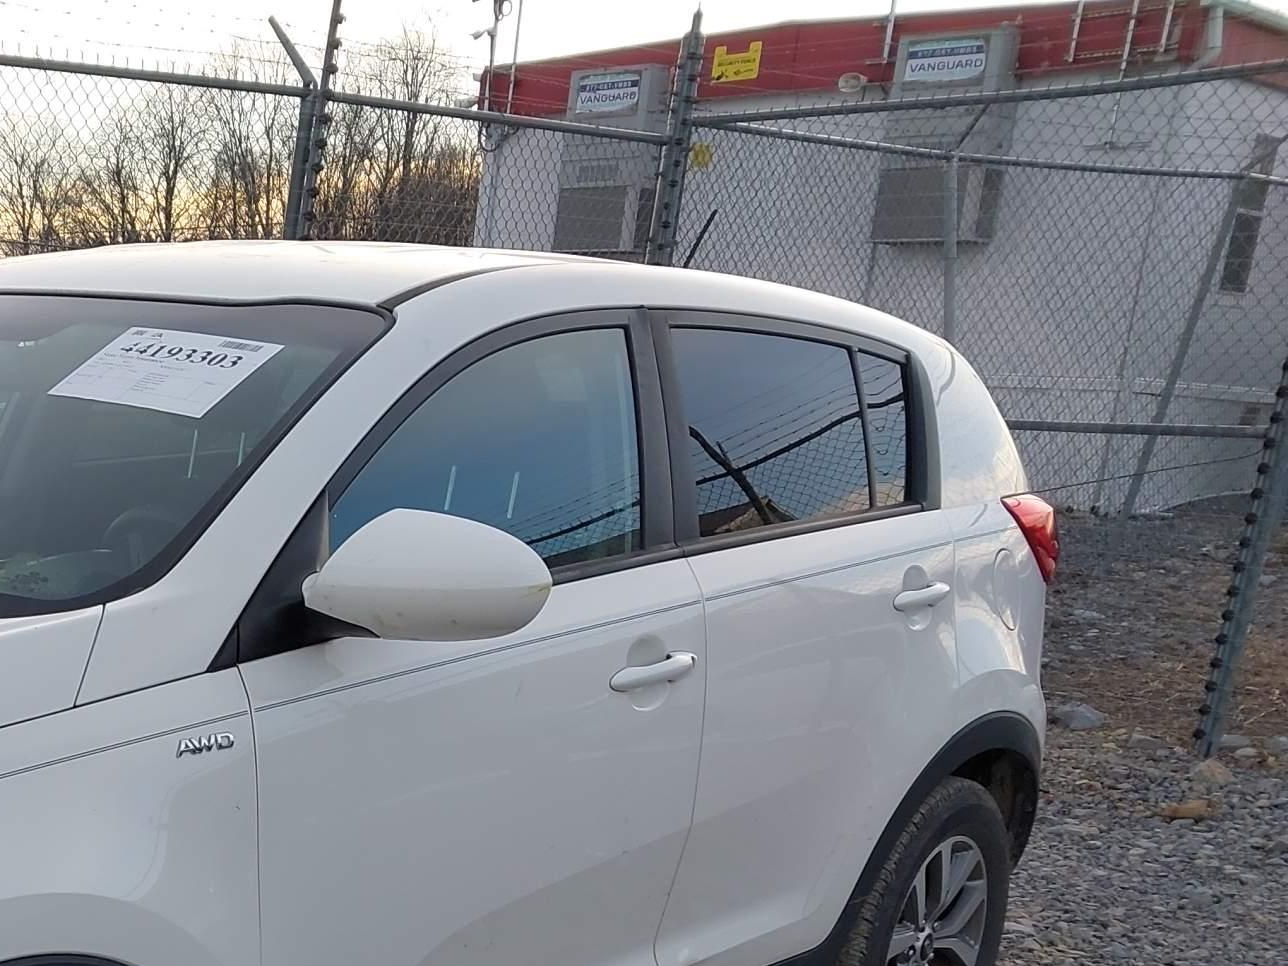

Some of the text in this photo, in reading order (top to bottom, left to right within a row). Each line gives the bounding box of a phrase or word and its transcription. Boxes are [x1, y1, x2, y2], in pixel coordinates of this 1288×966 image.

[910, 58, 983, 73] VANGUARD
[580, 91, 637, 105] VANGUARD
[120, 341, 244, 369] 44193303
[176, 731, 234, 758] AWD
